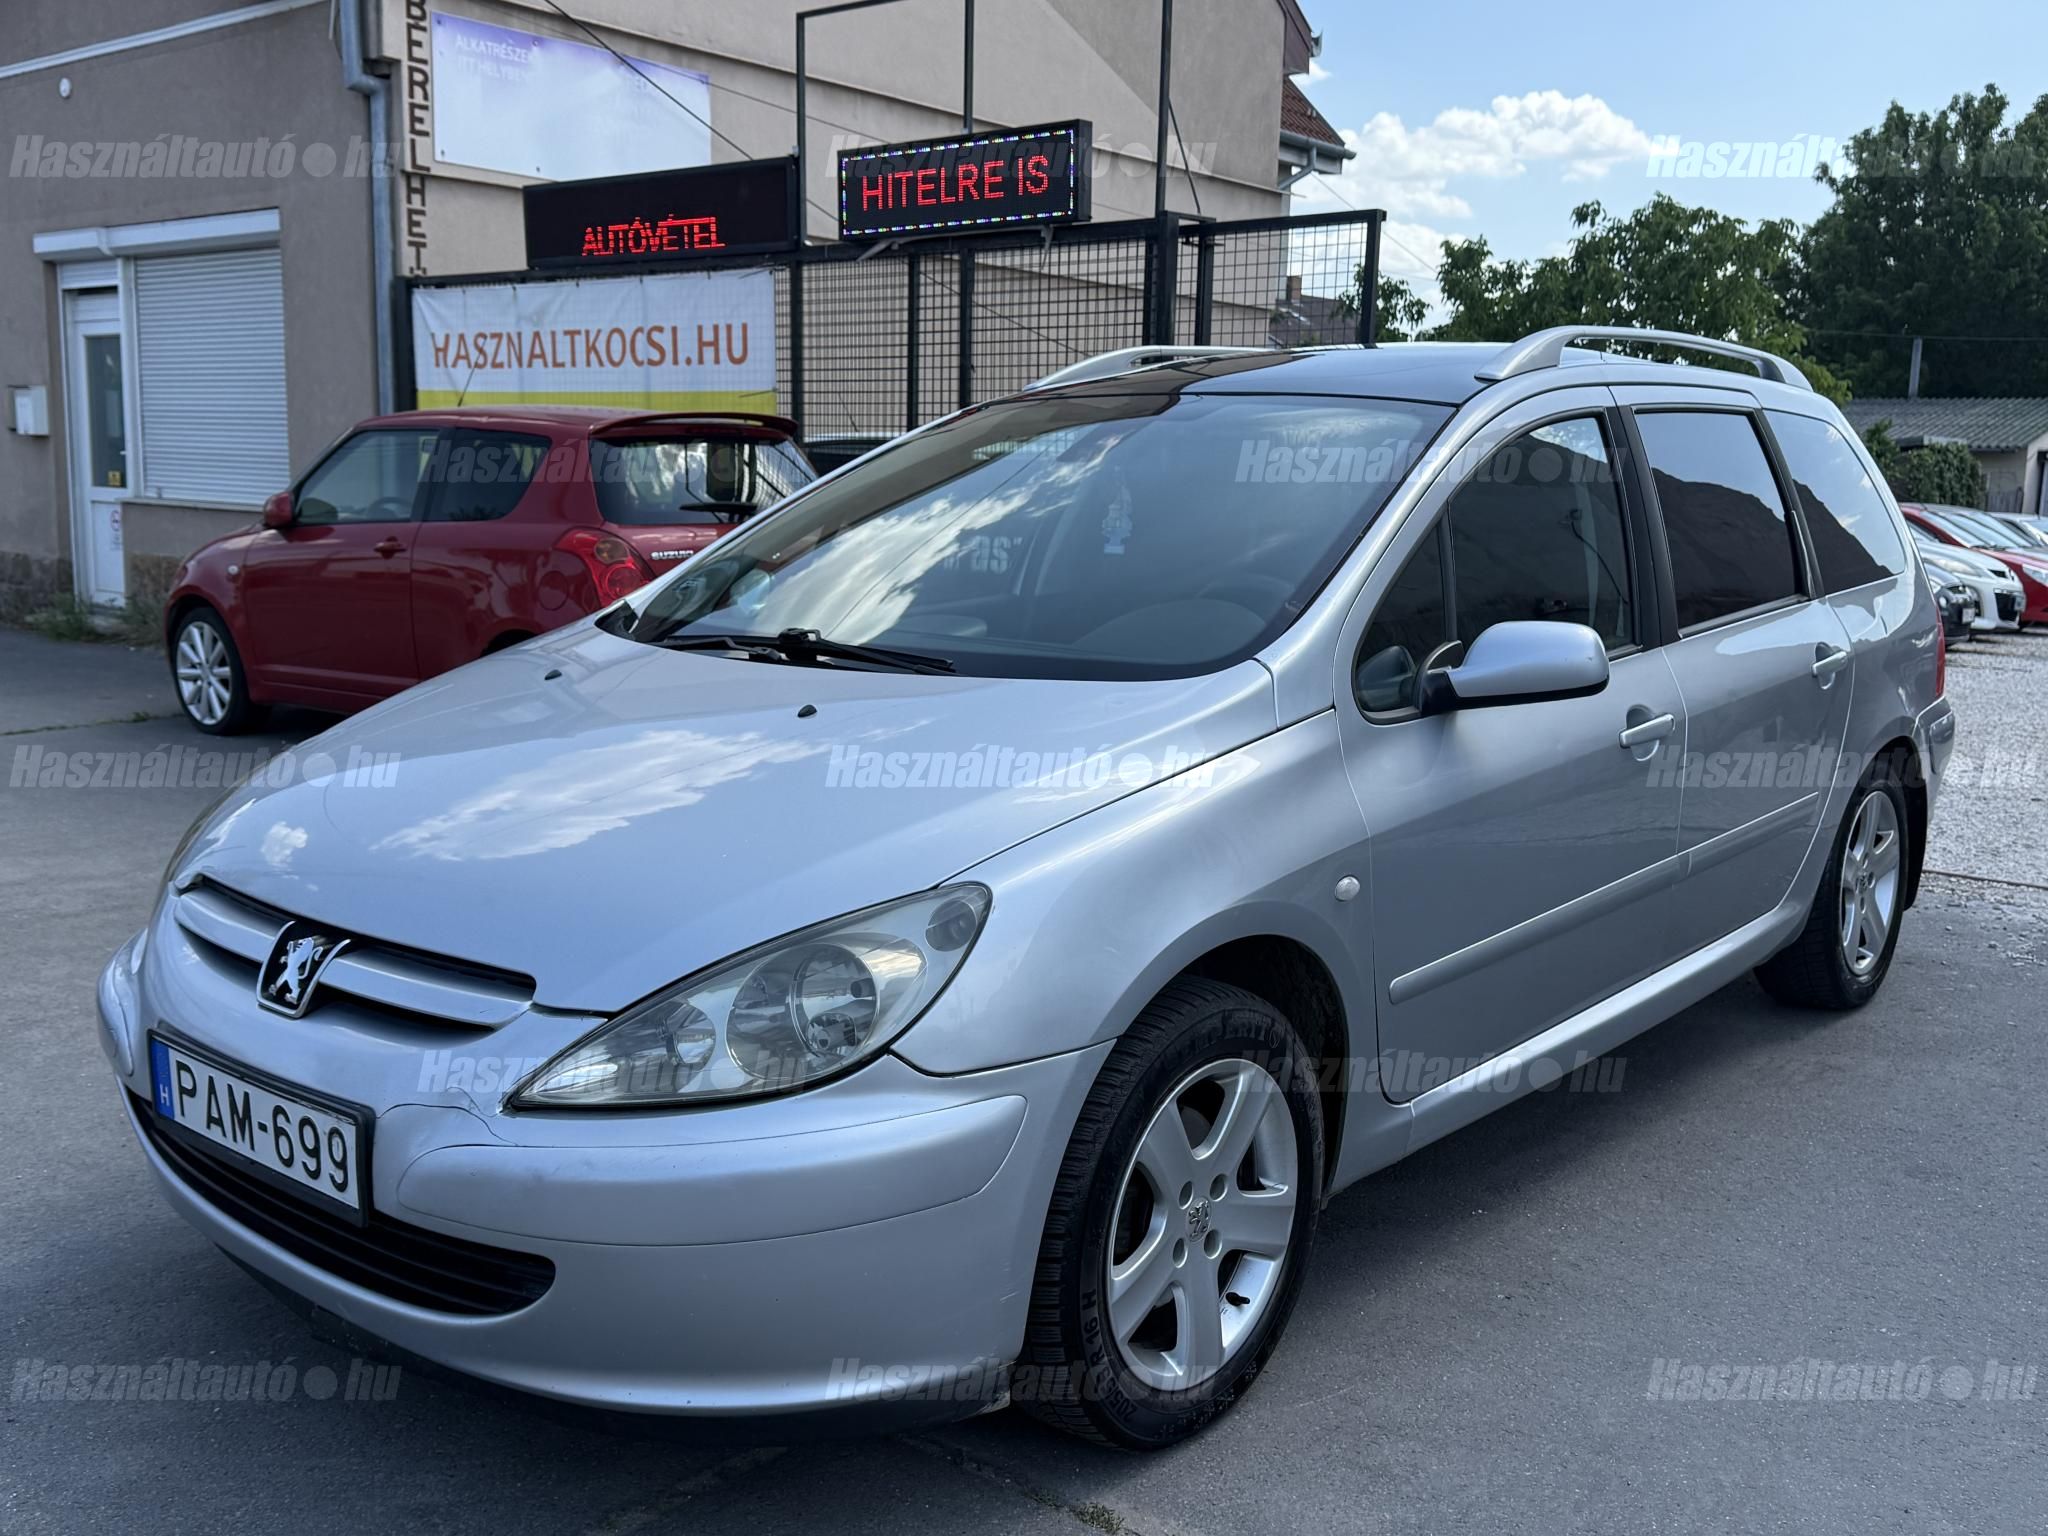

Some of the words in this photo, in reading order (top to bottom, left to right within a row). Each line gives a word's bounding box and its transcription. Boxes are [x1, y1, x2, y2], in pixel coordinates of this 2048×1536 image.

[862, 160, 1005, 212] HITELRE
[1018, 154, 1049, 196] IS
[582, 213, 726, 256] AUTÓVÉTEL
[431, 322, 749, 370] HASZNALTKOCSI.HU
[175, 1059, 349, 1193] PAM-699
[1081, 1289, 1097, 1311] H
[1083, 1316, 1101, 1345] 16
